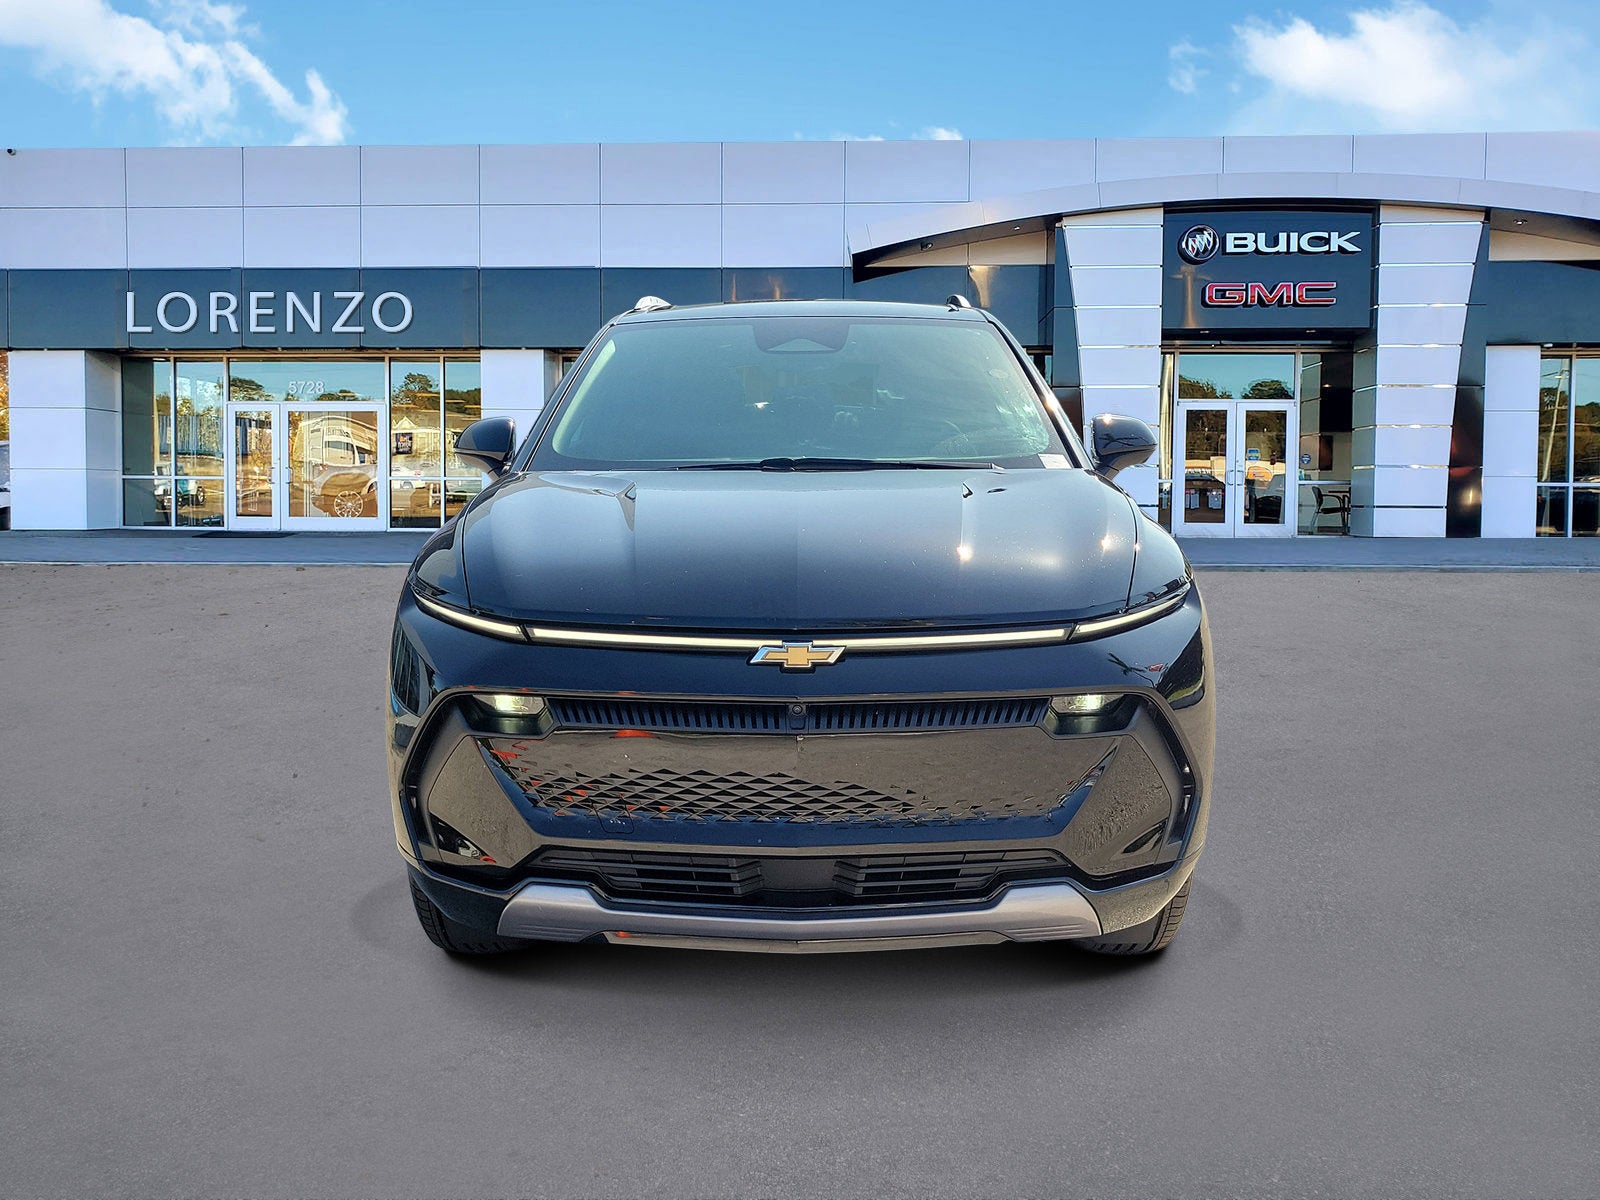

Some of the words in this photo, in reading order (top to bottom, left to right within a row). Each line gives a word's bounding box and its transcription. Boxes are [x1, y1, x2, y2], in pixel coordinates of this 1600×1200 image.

[1224, 231, 1363, 254] BUICK
[1205, 281, 1337, 306] GMC
[125, 290, 414, 334] LORENZO
[288, 380, 325, 395] 5728
